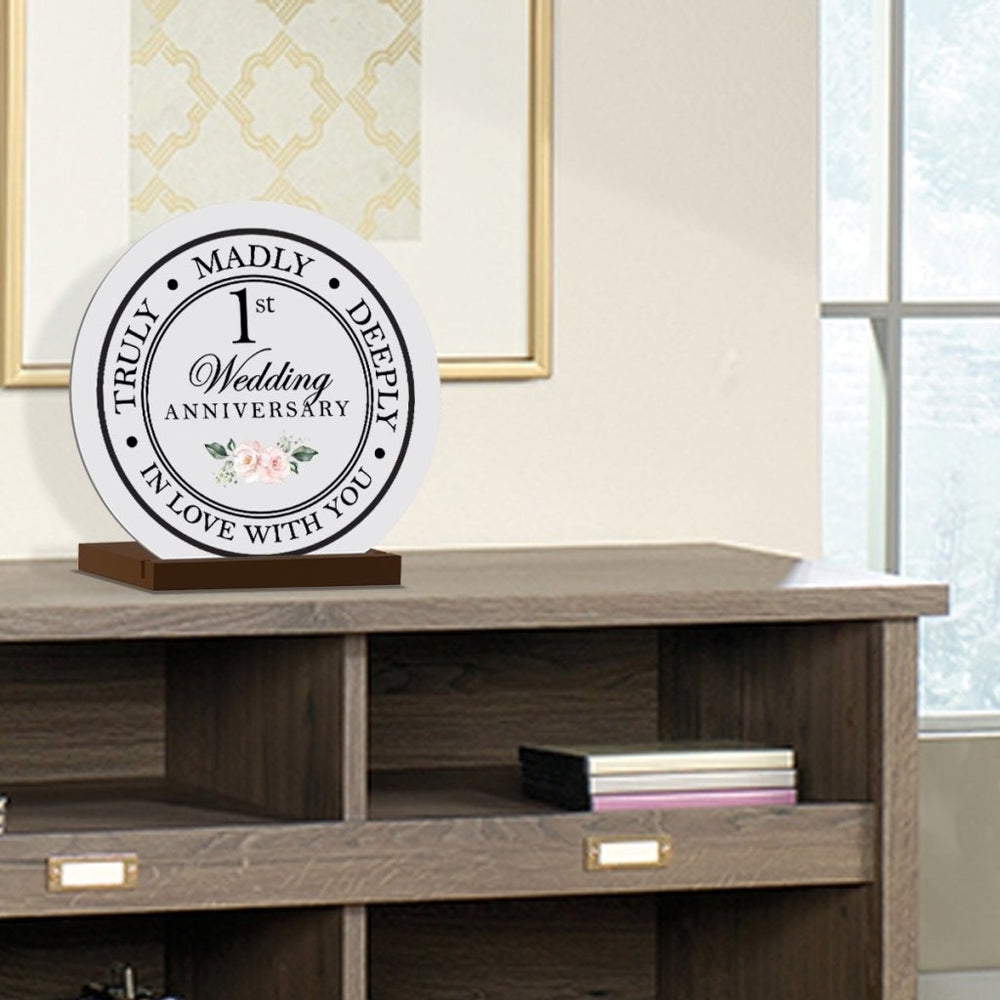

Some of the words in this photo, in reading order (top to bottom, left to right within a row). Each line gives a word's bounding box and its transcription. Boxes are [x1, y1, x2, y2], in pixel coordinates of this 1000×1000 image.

[112, 297, 160, 416] TRULY
[190, 243, 316, 281] MADLY
[345, 297, 399, 433] DEEPLY
[229, 287, 276, 345] 1st
[188, 347, 334, 407] Wedding
[164, 400, 350, 421] ANNIVERSARY
[139, 461, 172, 495] IN
[166, 490, 236, 541] LOVE
[243, 511, 324, 545] WITH
[322, 466, 372, 519] YOU
